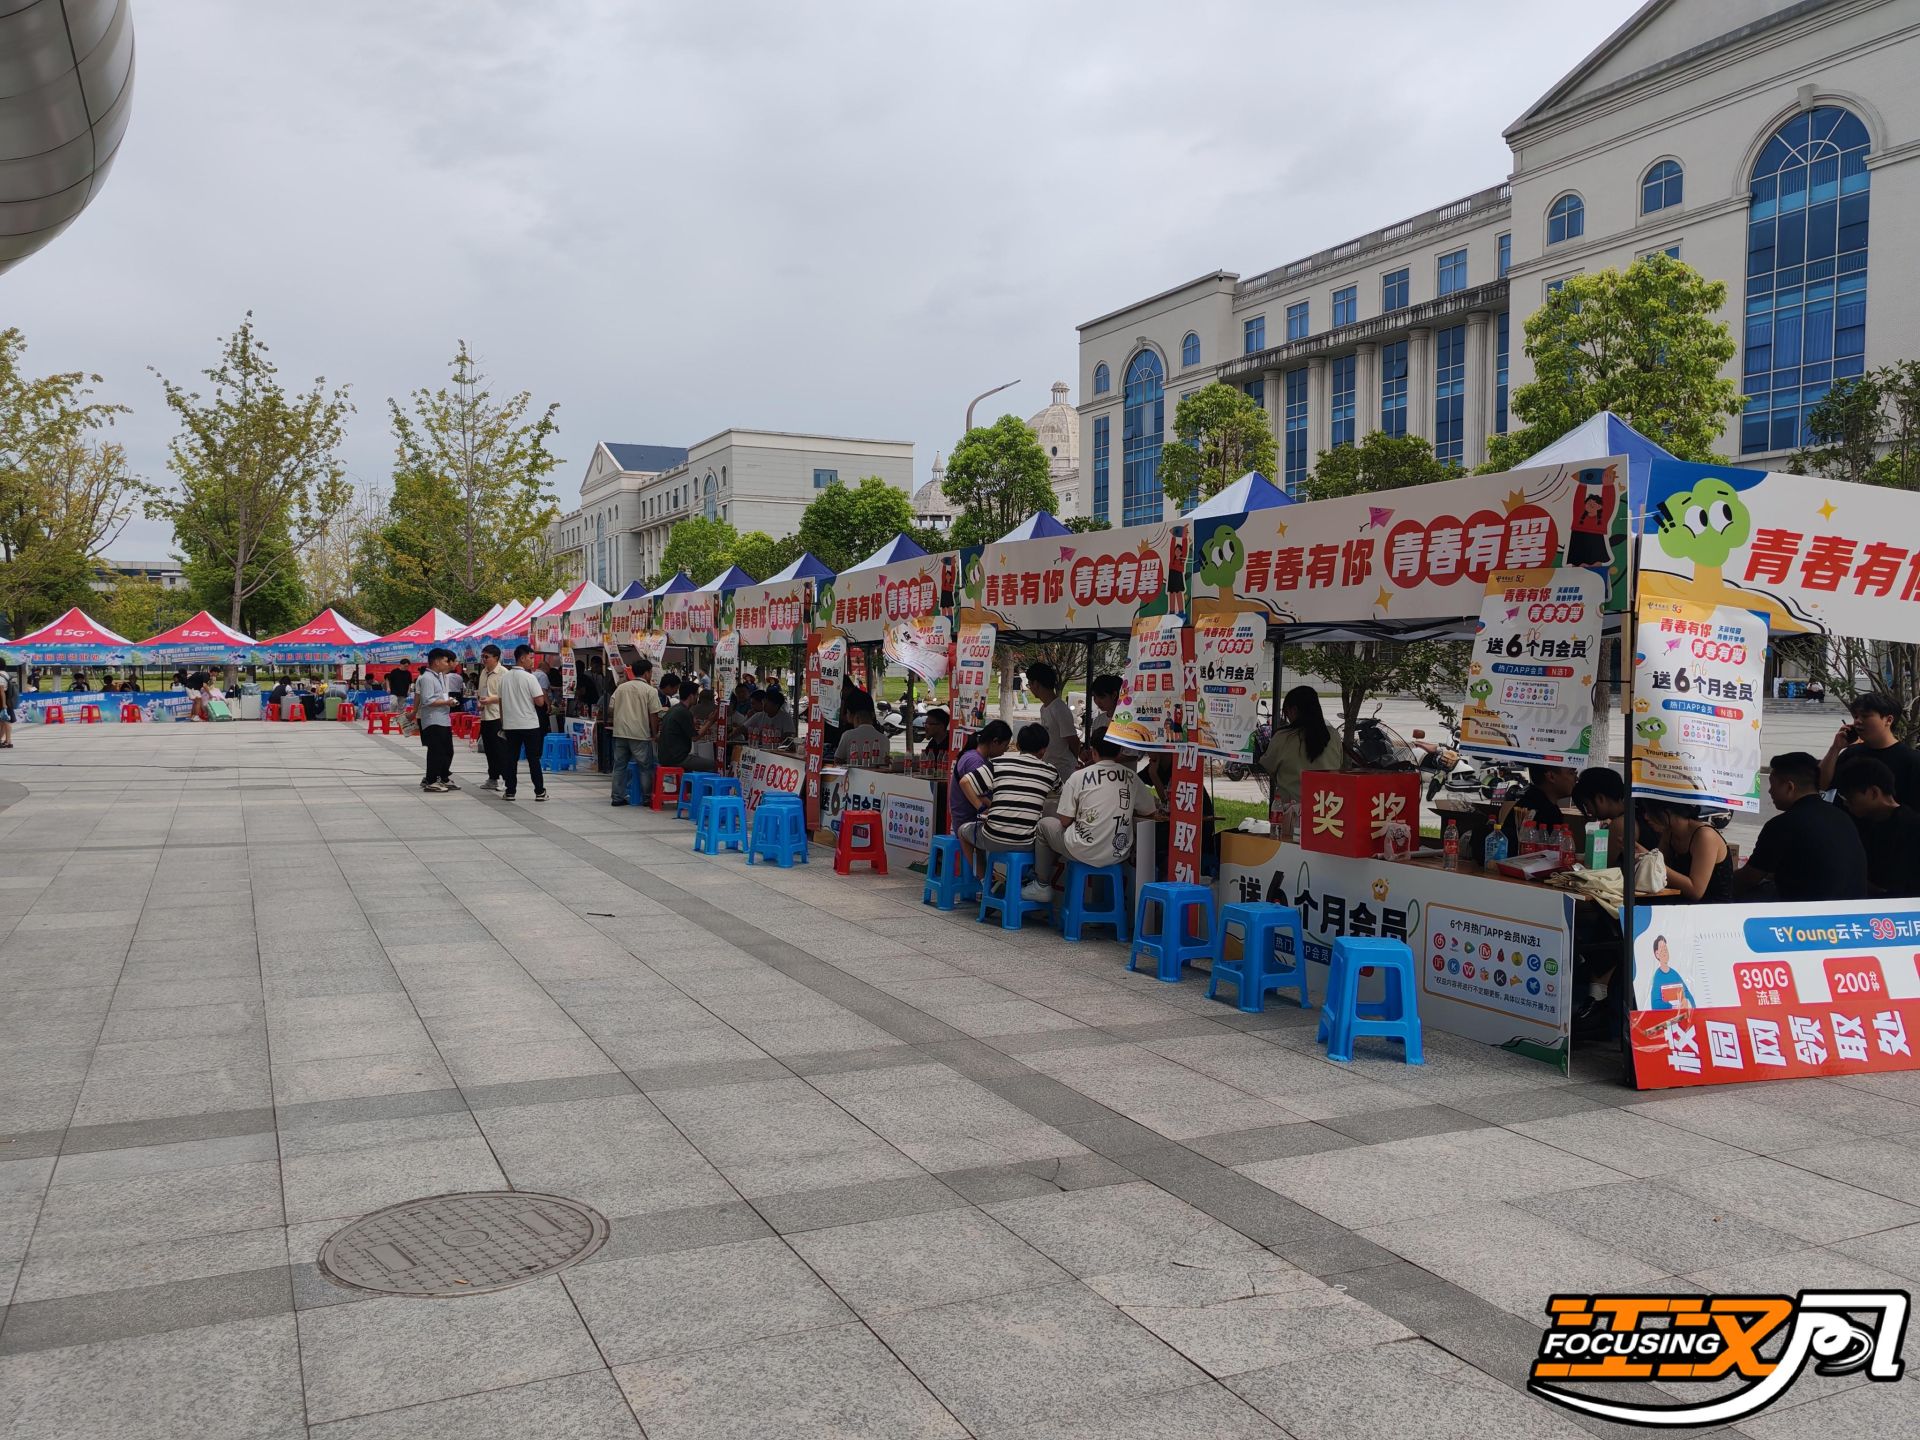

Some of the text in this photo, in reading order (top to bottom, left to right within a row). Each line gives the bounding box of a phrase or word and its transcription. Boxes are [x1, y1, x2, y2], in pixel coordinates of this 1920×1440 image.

[1245, 516, 1550, 593] 青春有你 青春有翼
[987, 558, 1160, 606] 青春有你 青春有翼
[1504, 588, 1551, 602] 青春有你
[736, 606, 766, 629] 青春有你
[836, 582, 934, 624] 青春有你 青春有翼
[1660, 618, 1712, 638] 青春有你
[1486, 634, 1587, 658] 送6个月会员
[1652, 668, 1753, 702] 送6个月会员
[1313, 790, 1344, 838] 奖
[1371, 792, 1406, 839] 奖
[1740, 967, 1789, 990] 390G
[1834, 972, 1870, 993] 200
[1756, 989, 1782, 1005] 流量
[1665, 1010, 1912, 1074] 校园网领取处
